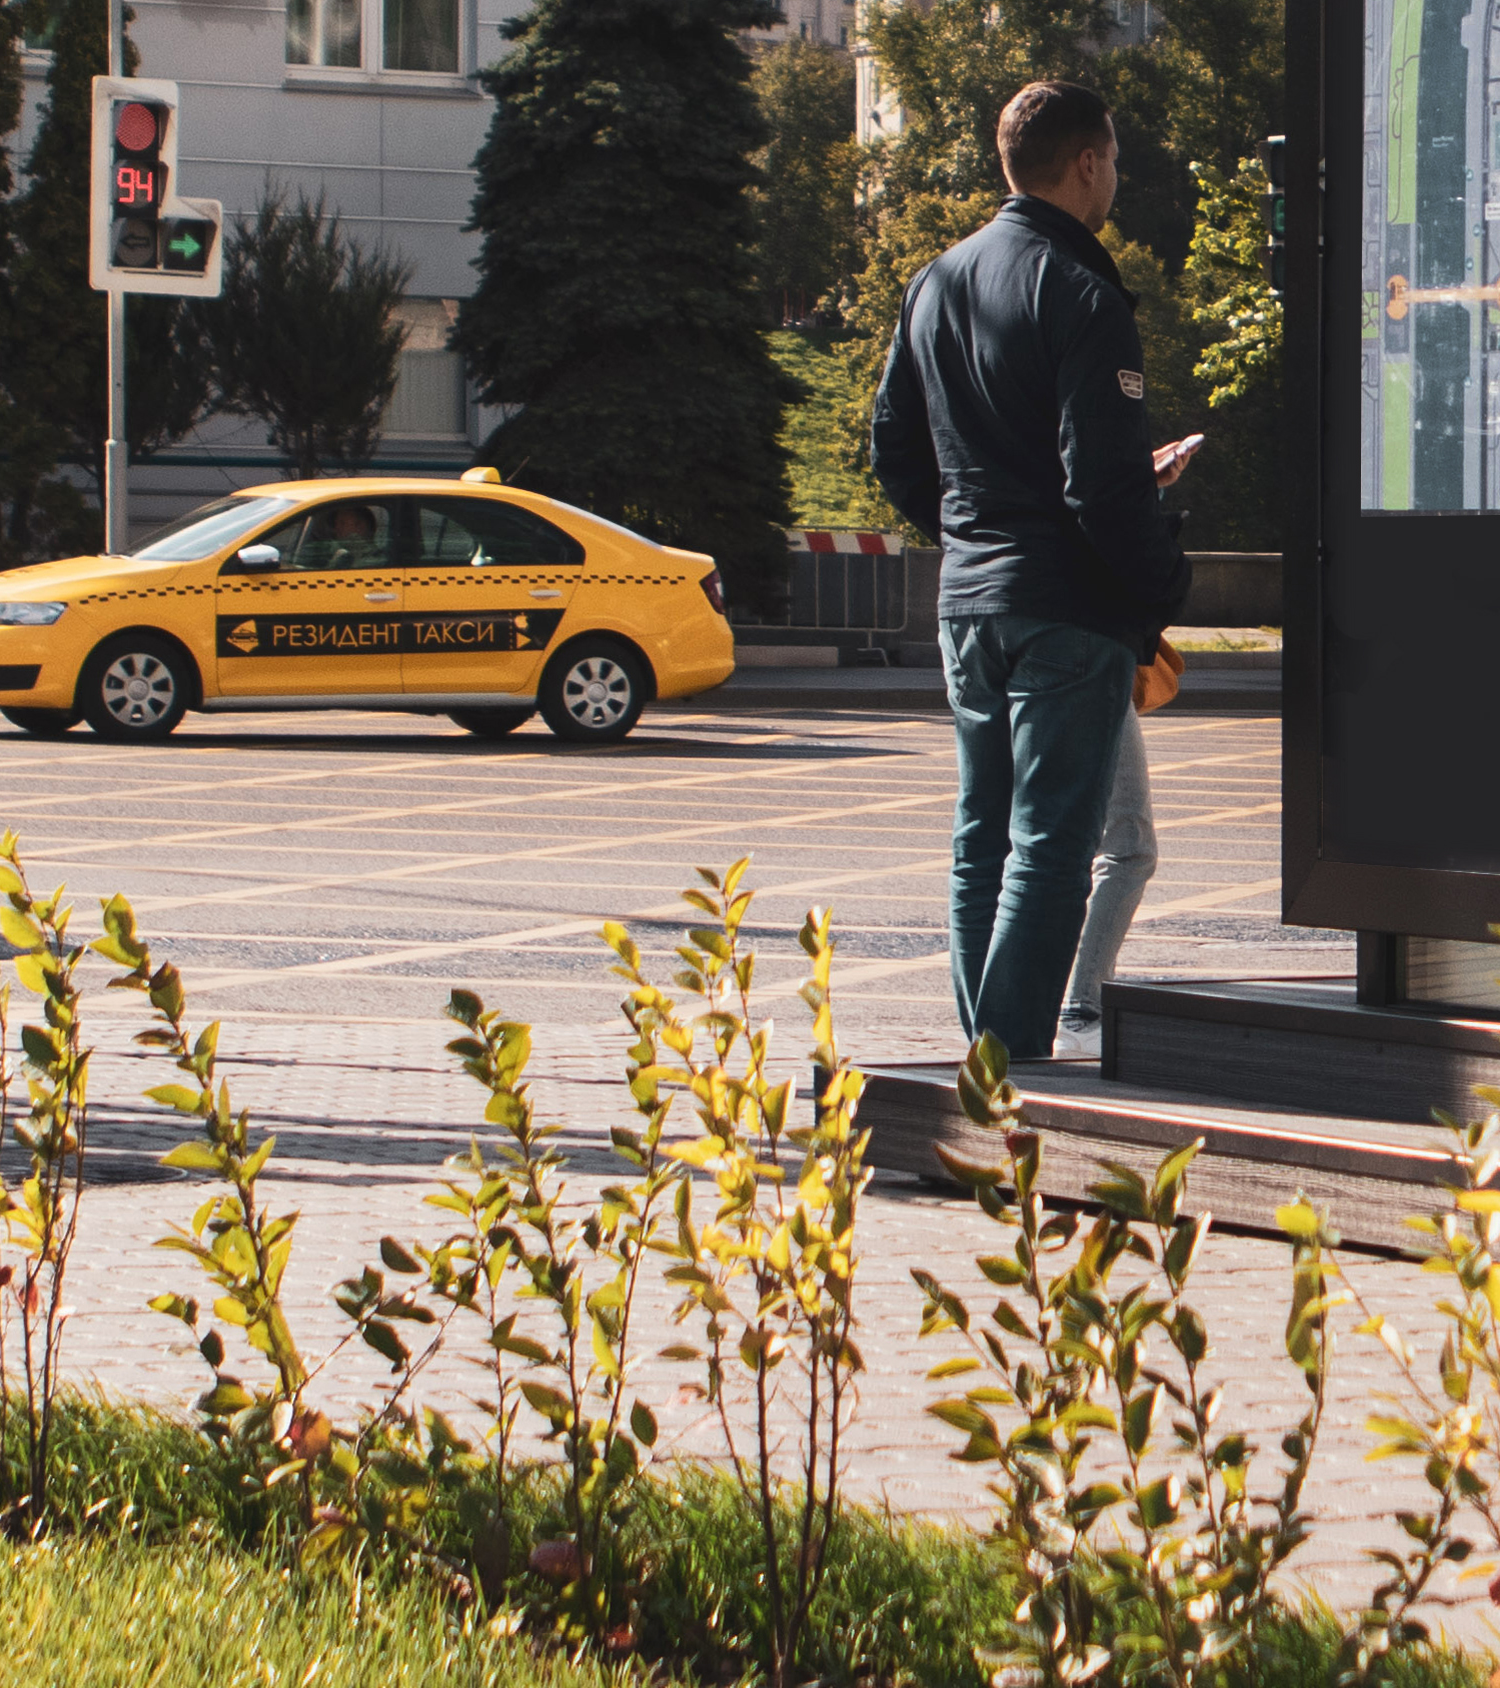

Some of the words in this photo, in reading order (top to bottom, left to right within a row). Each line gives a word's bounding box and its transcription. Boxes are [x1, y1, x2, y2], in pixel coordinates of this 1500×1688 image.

[117, 167, 154, 204] 94
[272, 622, 402, 649] РЕЗИДЕНТ
[412, 619, 495, 645] ТАКСИ
